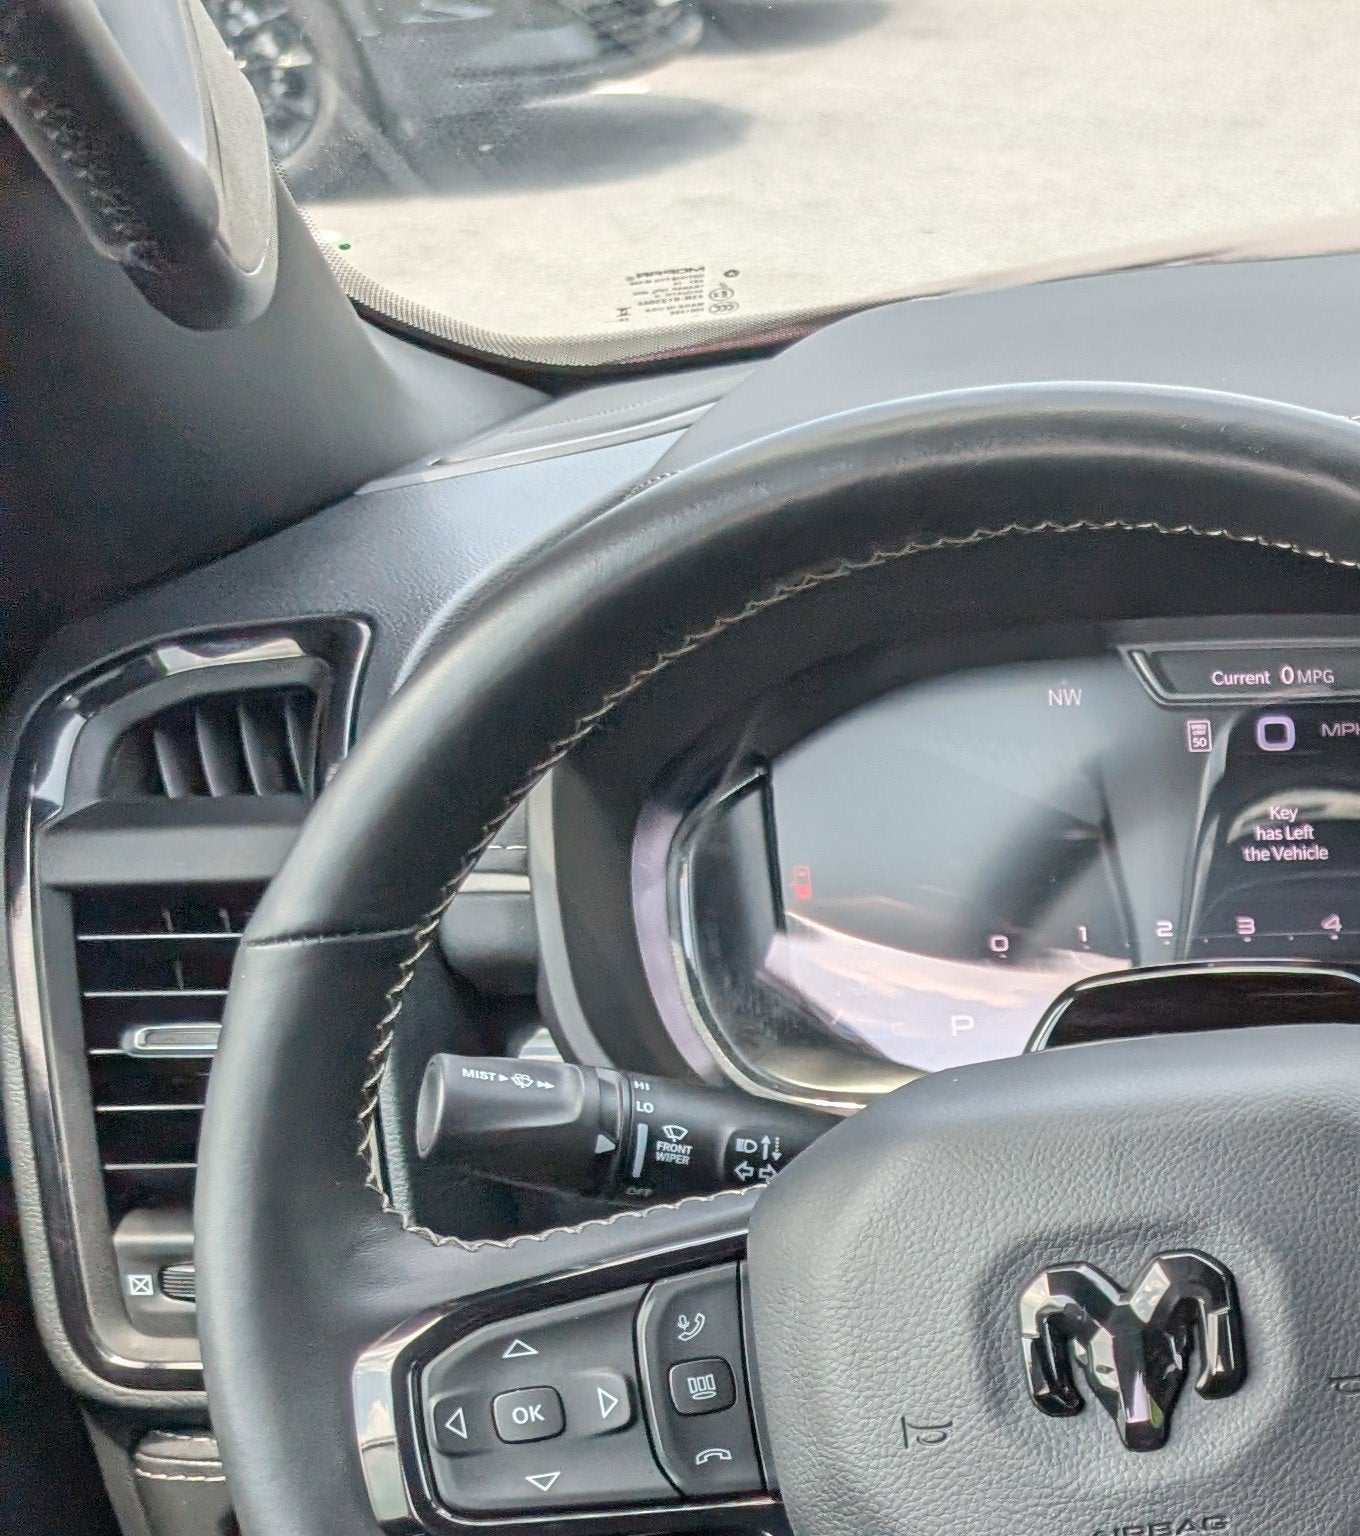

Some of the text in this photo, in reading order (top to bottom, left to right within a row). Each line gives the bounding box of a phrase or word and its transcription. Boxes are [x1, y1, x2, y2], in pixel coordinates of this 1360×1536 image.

[1211, 665, 1335, 686] Current 0 MPG
[1048, 688, 1082, 706] NW
[1270, 806, 1298, 823] Key
[1256, 824, 1315, 841] has Left
[1243, 845, 1329, 861] the Vehicle
[1155, 921, 1174, 939] 2
[1235, 916, 1257, 936] 3
[1321, 914, 1343, 933] 4
[990, 935, 1009, 953] 0
[1078, 926, 1089, 944] 1
[951, 1014, 975, 1037] P
[461, 1067, 498, 1083] MIST
[636, 1100, 655, 1115] LO
[655, 1140, 694, 1155] FRONT
[655, 1151, 690, 1166] WIPER
[512, 1404, 545, 1424] OK
